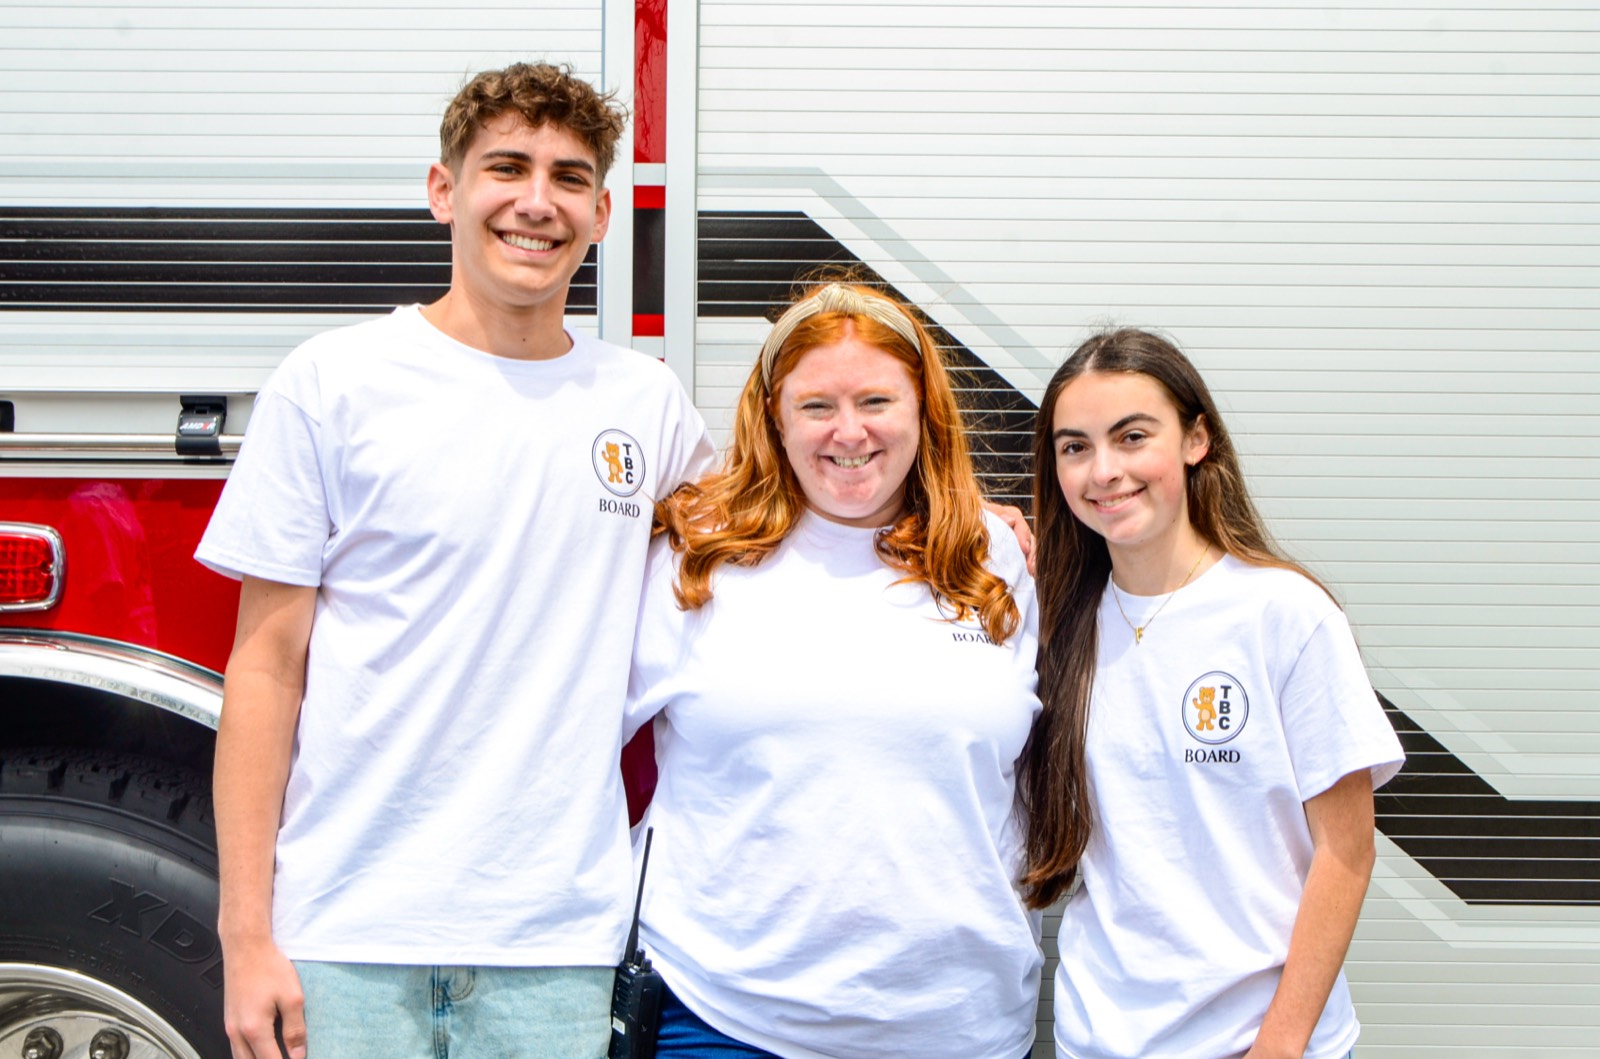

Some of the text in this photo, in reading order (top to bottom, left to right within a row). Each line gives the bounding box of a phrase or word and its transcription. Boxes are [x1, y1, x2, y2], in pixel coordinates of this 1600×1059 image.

[622, 443, 634, 485] TBC
[599, 498, 641, 519] BOARD
[952, 632, 1003, 647] BOAR
[1219, 685, 1232, 731] TBC
[1184, 748, 1241, 764] BOARD
